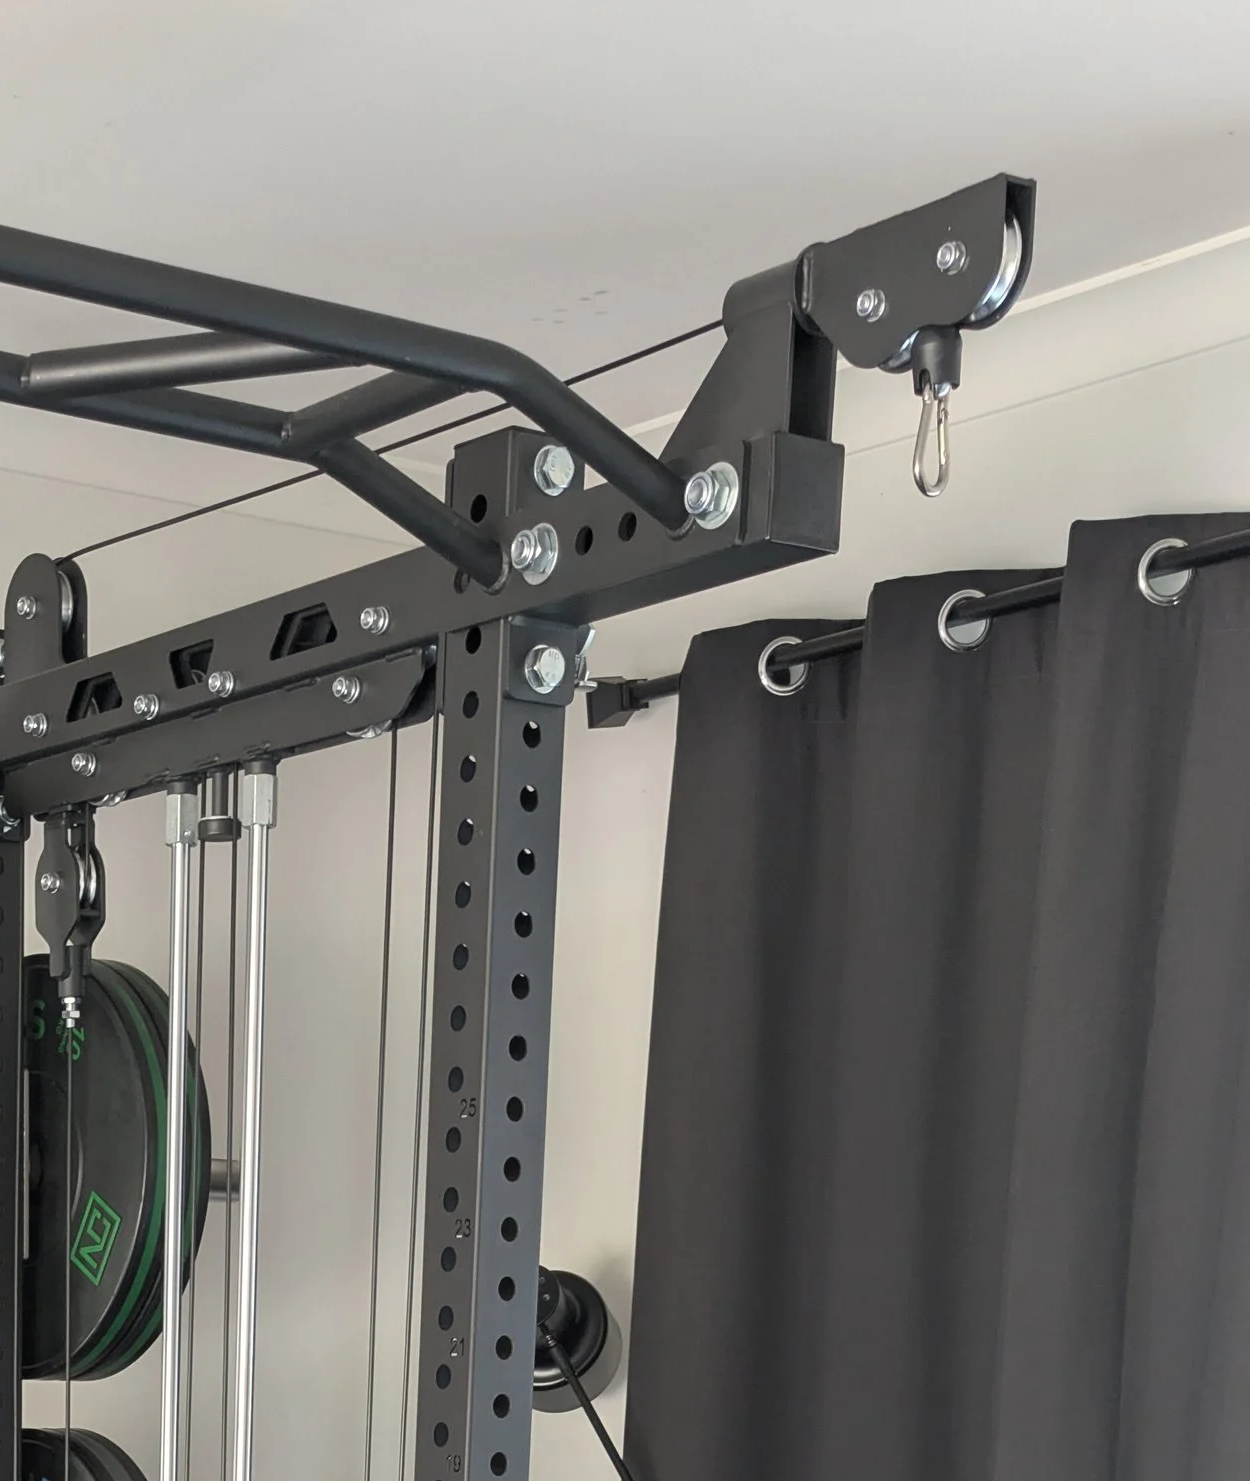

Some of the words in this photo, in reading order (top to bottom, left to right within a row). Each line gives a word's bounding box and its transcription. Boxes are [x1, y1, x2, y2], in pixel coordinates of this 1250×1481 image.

[460, 1097, 477, 1119] 25
[454, 1217, 472, 1239] 23
[450, 1336, 465, 1357] 21
[445, 1453, 462, 1473] 19
